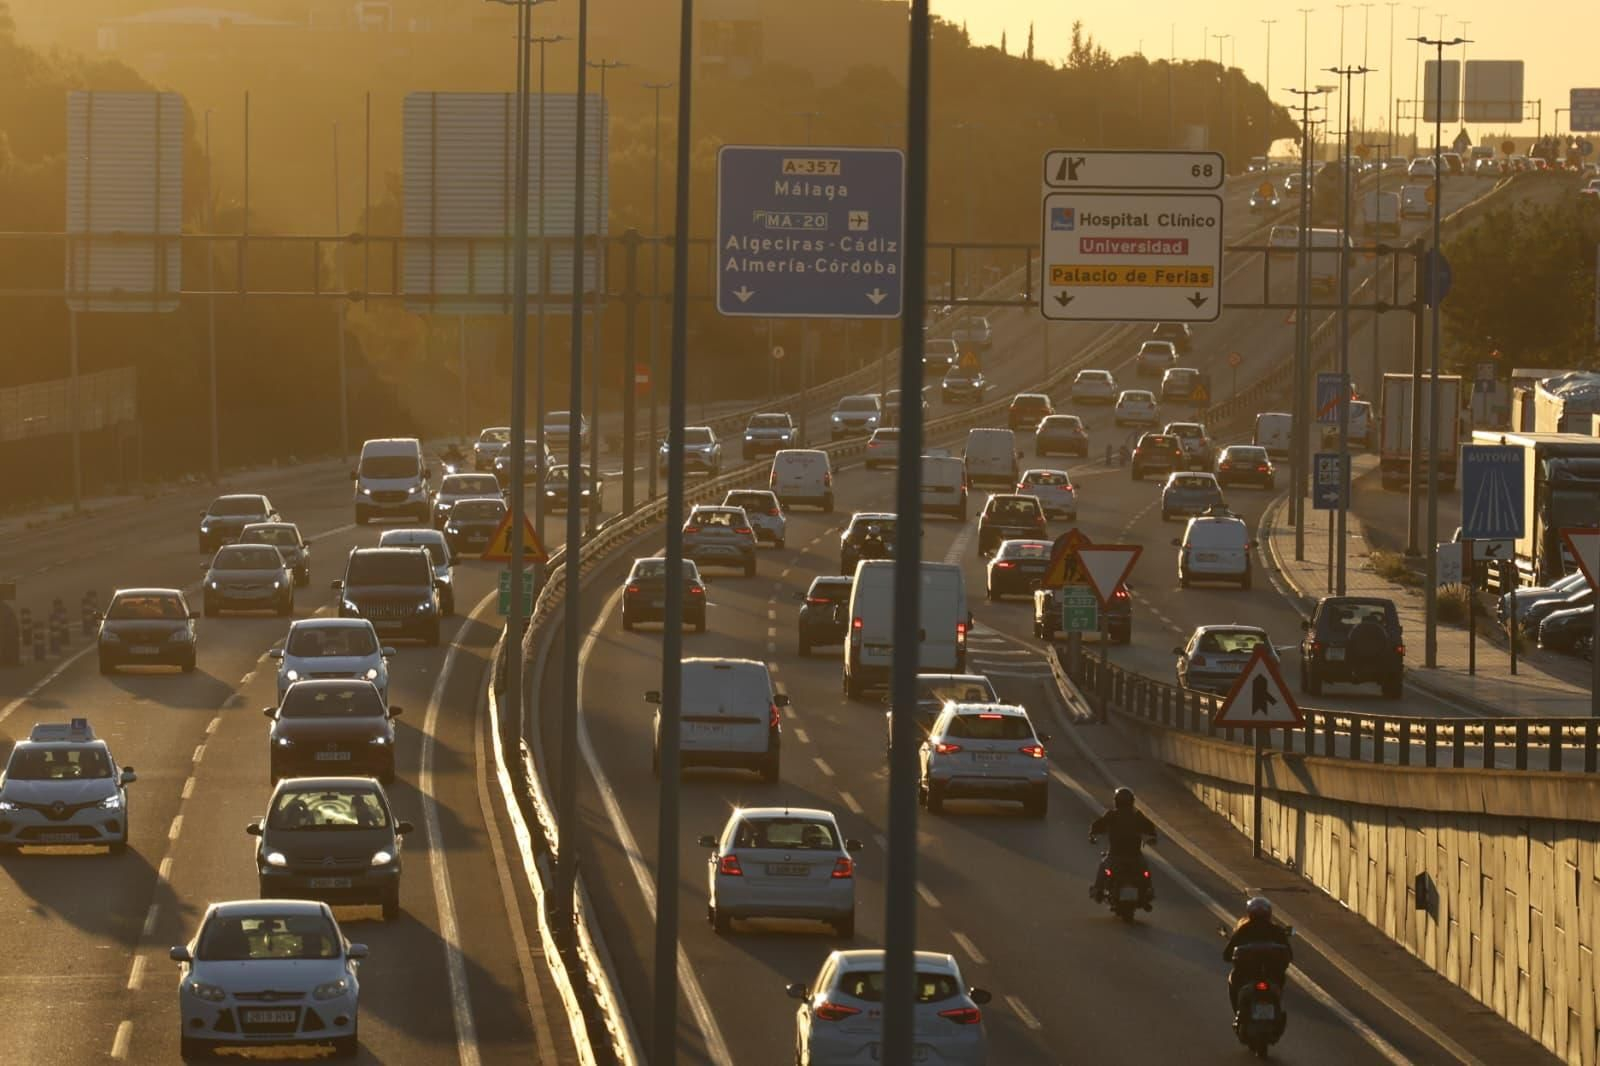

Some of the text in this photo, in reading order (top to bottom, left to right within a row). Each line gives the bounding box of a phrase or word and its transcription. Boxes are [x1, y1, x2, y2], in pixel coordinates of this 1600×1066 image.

[785, 160, 838, 173] A-357
[1191, 164, 1213, 177] 68
[775, 181, 848, 200] Málaga
[767, 215, 826, 228] MA-20
[1079, 212, 1216, 229] Hospital Clínico
[726, 235, 825, 254] Algeciras
[840, 236, 897, 252] Cádiz
[1082, 239, 1183, 254] Universidad
[1052, 268, 1209, 284] Palacio de Ferias
[1071, 618, 1089, 628] 67
